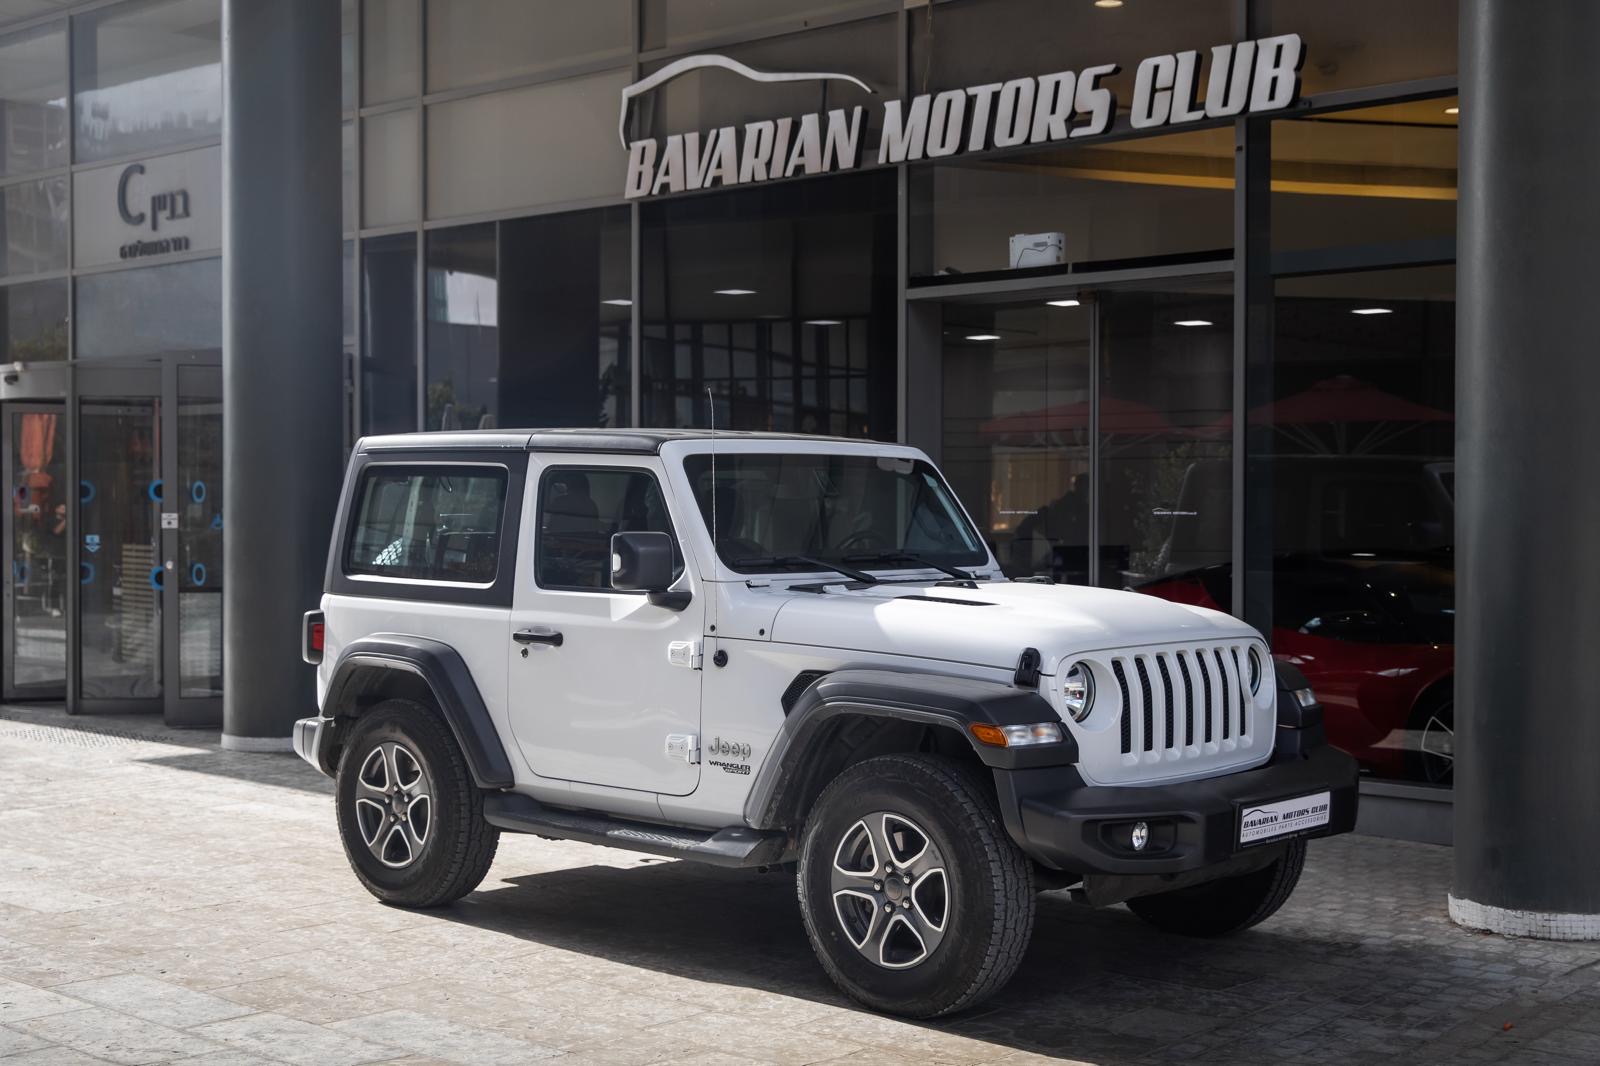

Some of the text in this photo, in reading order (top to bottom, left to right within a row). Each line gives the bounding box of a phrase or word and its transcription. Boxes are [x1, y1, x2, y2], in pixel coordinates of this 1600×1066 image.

[624, 33, 1302, 199] BAVARIAN MOTORS CLUB
[117, 163, 145, 226] C
[708, 736, 751, 761] Jeep
[708, 760, 751, 771] WRANGLER
[1243, 804, 1328, 829] BAVARIAN MOTORS CLUB
